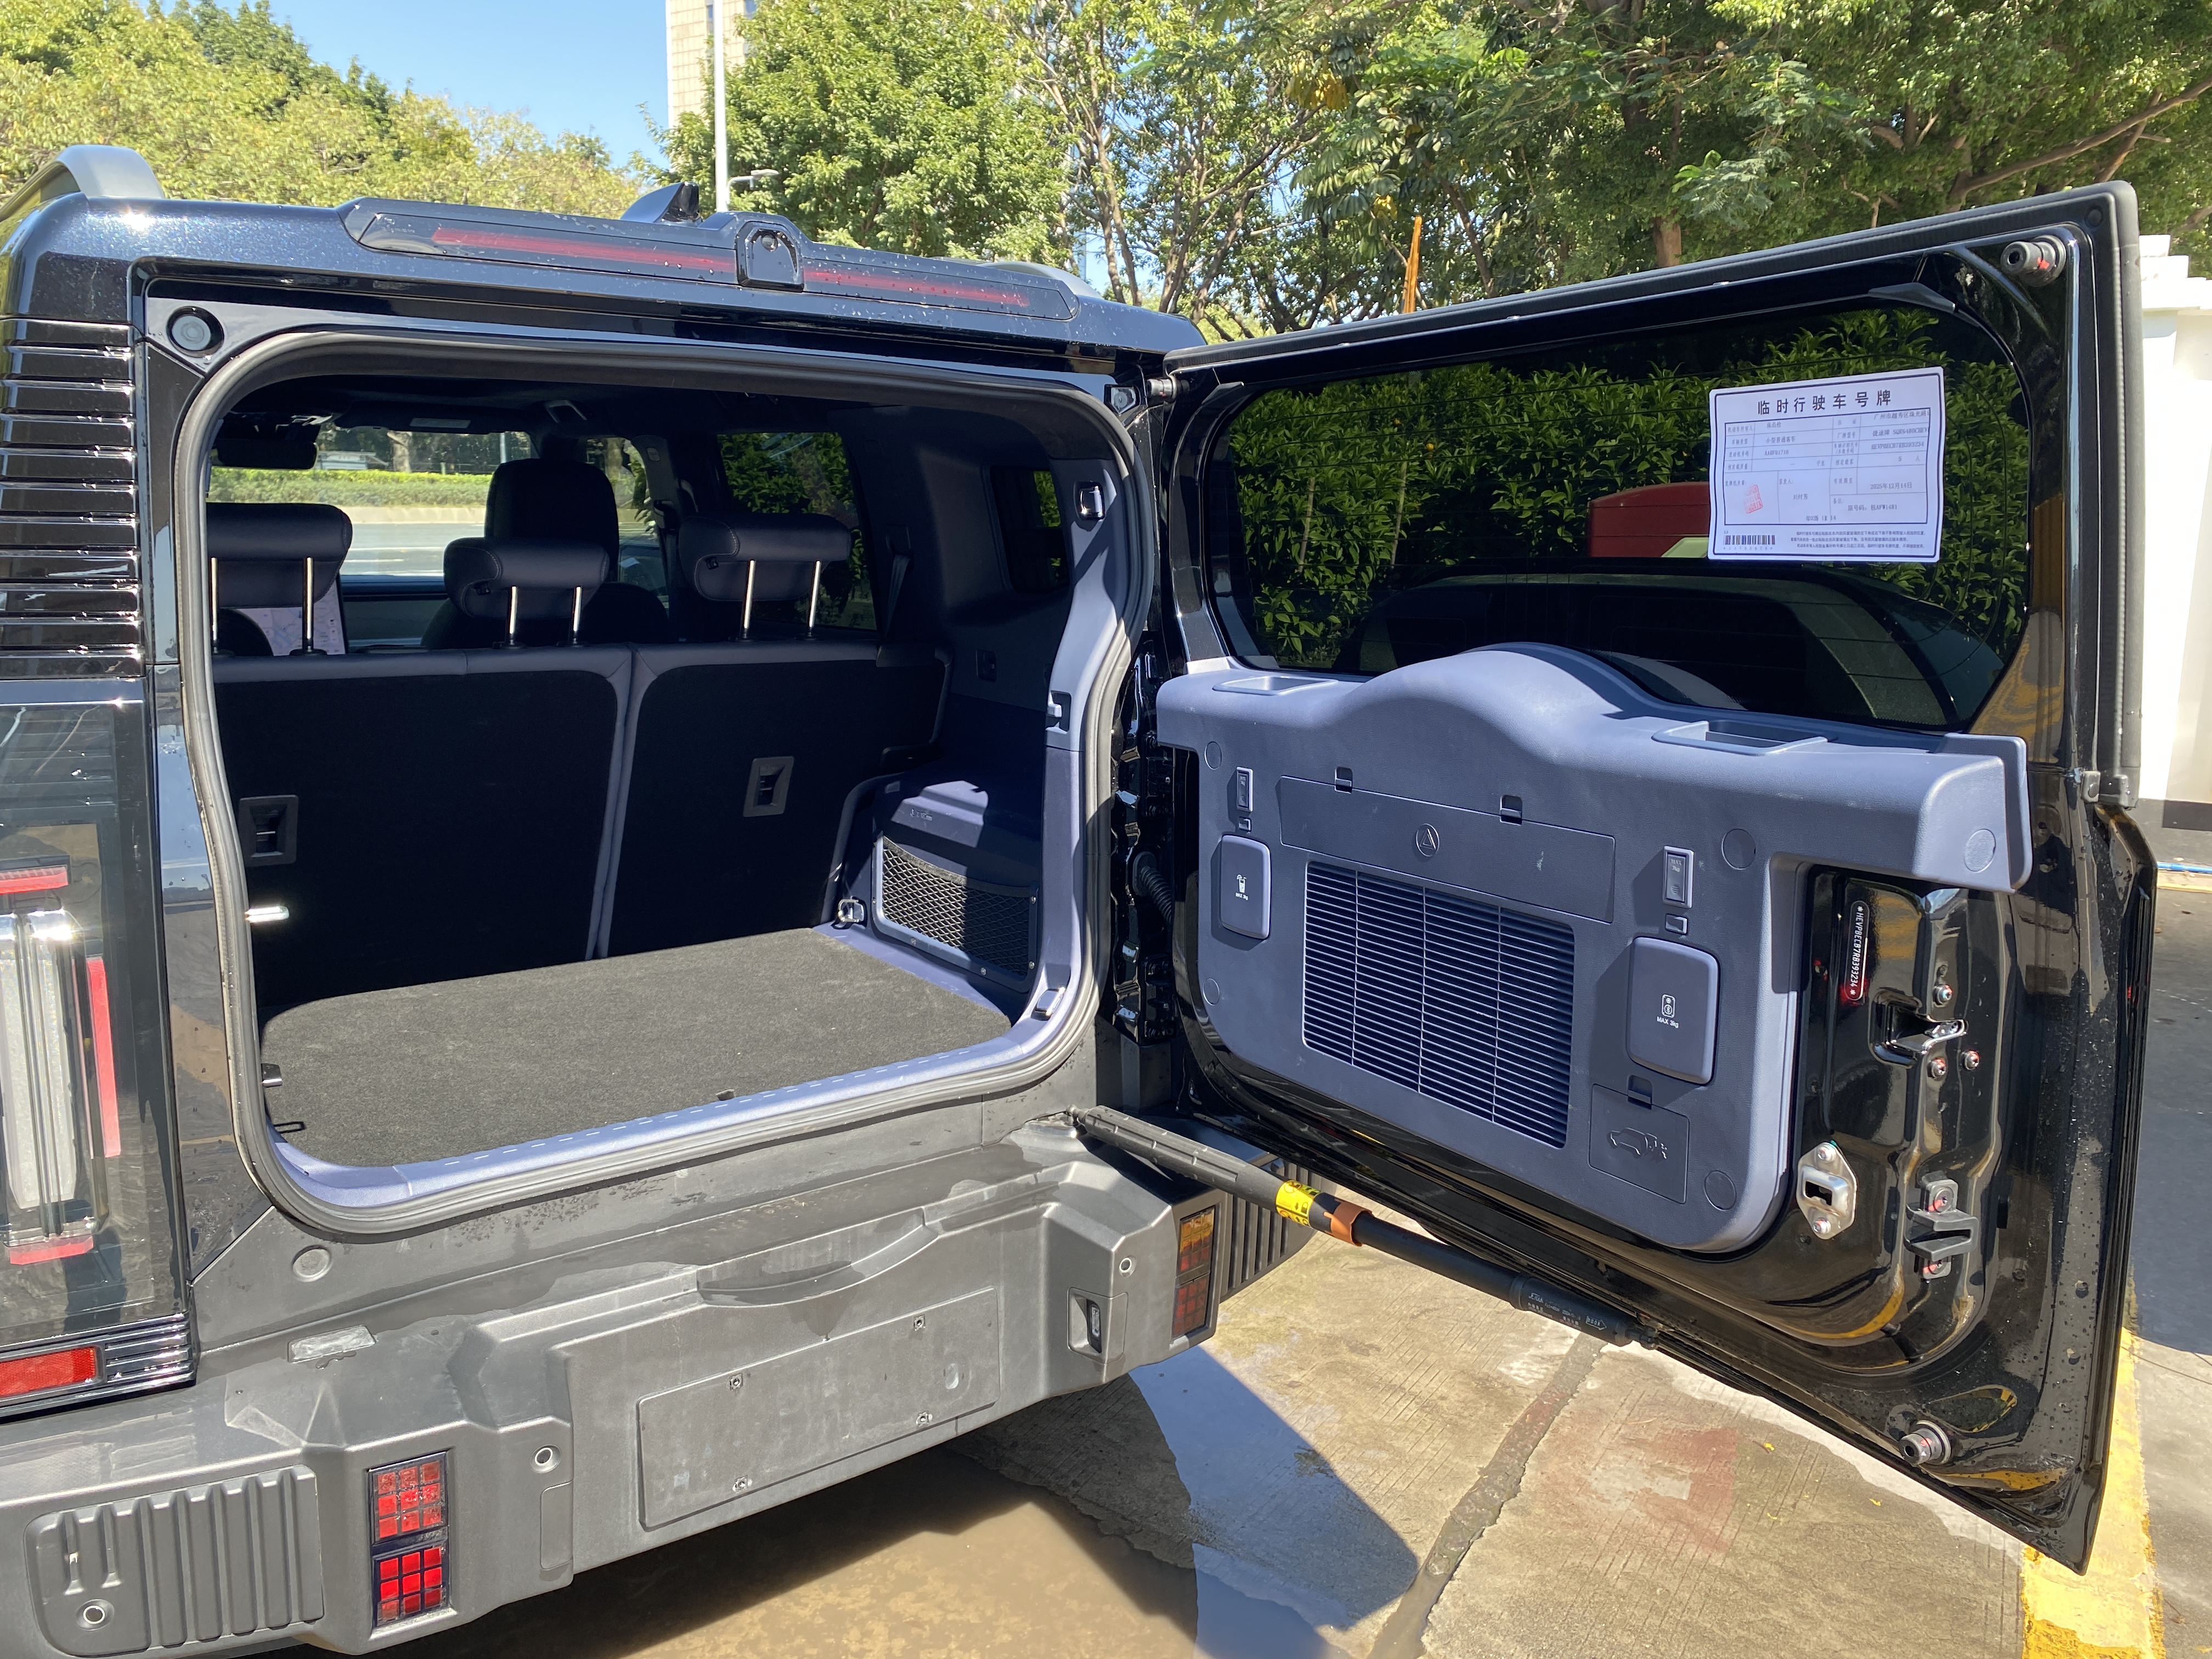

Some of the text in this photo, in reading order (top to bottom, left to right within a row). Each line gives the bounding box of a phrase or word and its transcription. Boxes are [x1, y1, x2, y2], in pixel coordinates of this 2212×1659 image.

[1758, 390, 1892, 415] 临时行驶车号牌
[1870, 482, 1912, 490] 2025年12月14日
[1657, 1016, 1669, 1024] MAX
